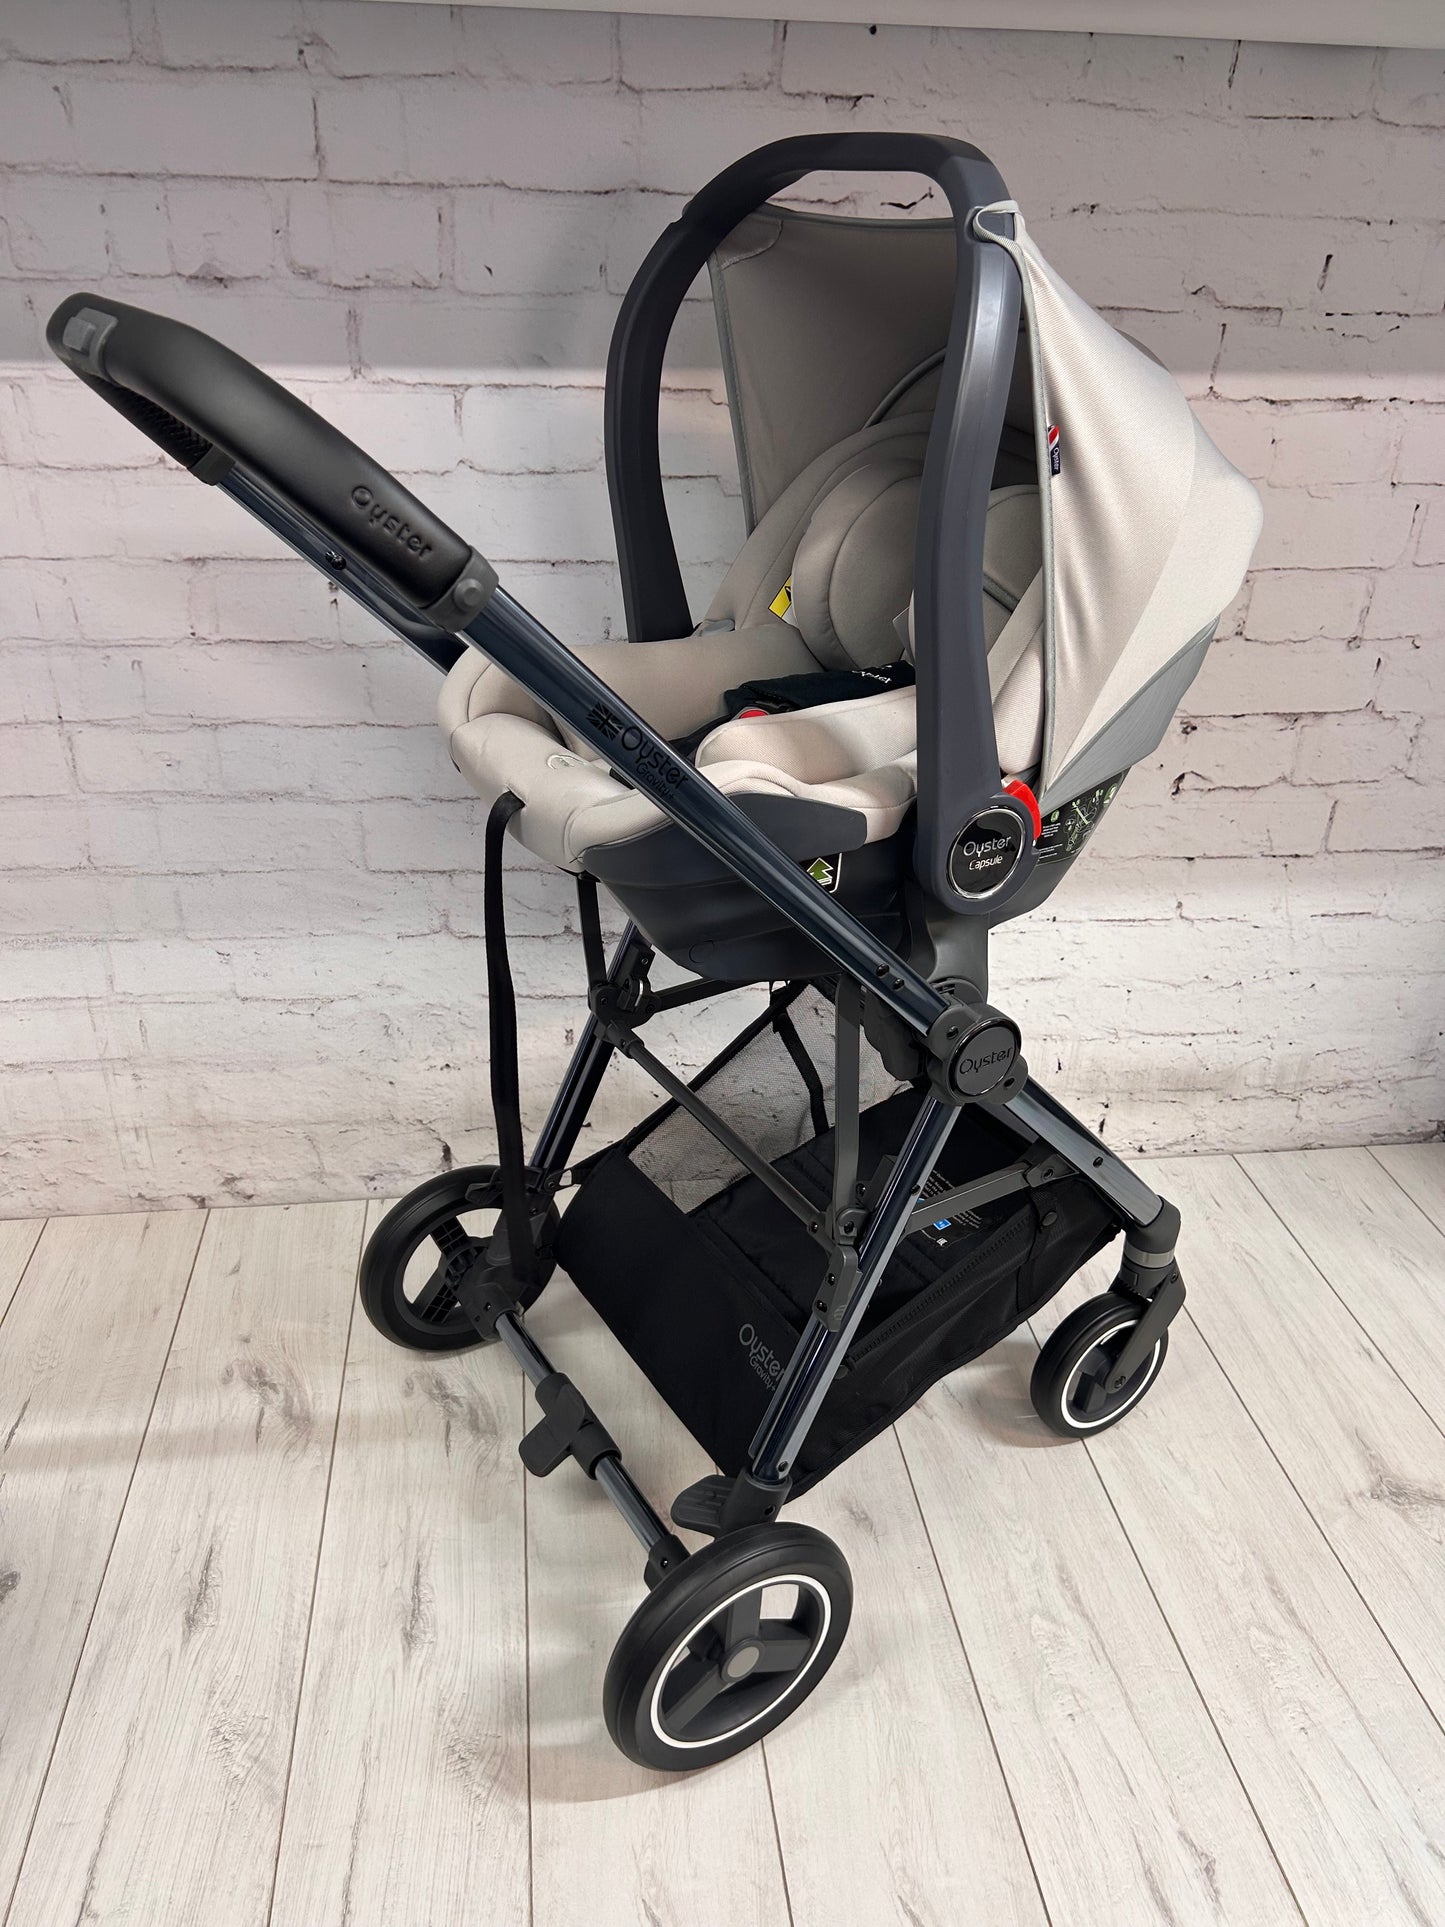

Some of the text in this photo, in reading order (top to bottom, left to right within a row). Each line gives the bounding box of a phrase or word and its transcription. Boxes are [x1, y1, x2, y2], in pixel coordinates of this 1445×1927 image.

[351, 485, 433, 557] Oyster
[621, 726, 689, 789] Oyster
[963, 836, 1012, 858] Oyster
[968, 854, 1003, 871] Capsule
[959, 1047, 1013, 1075] Oyster
